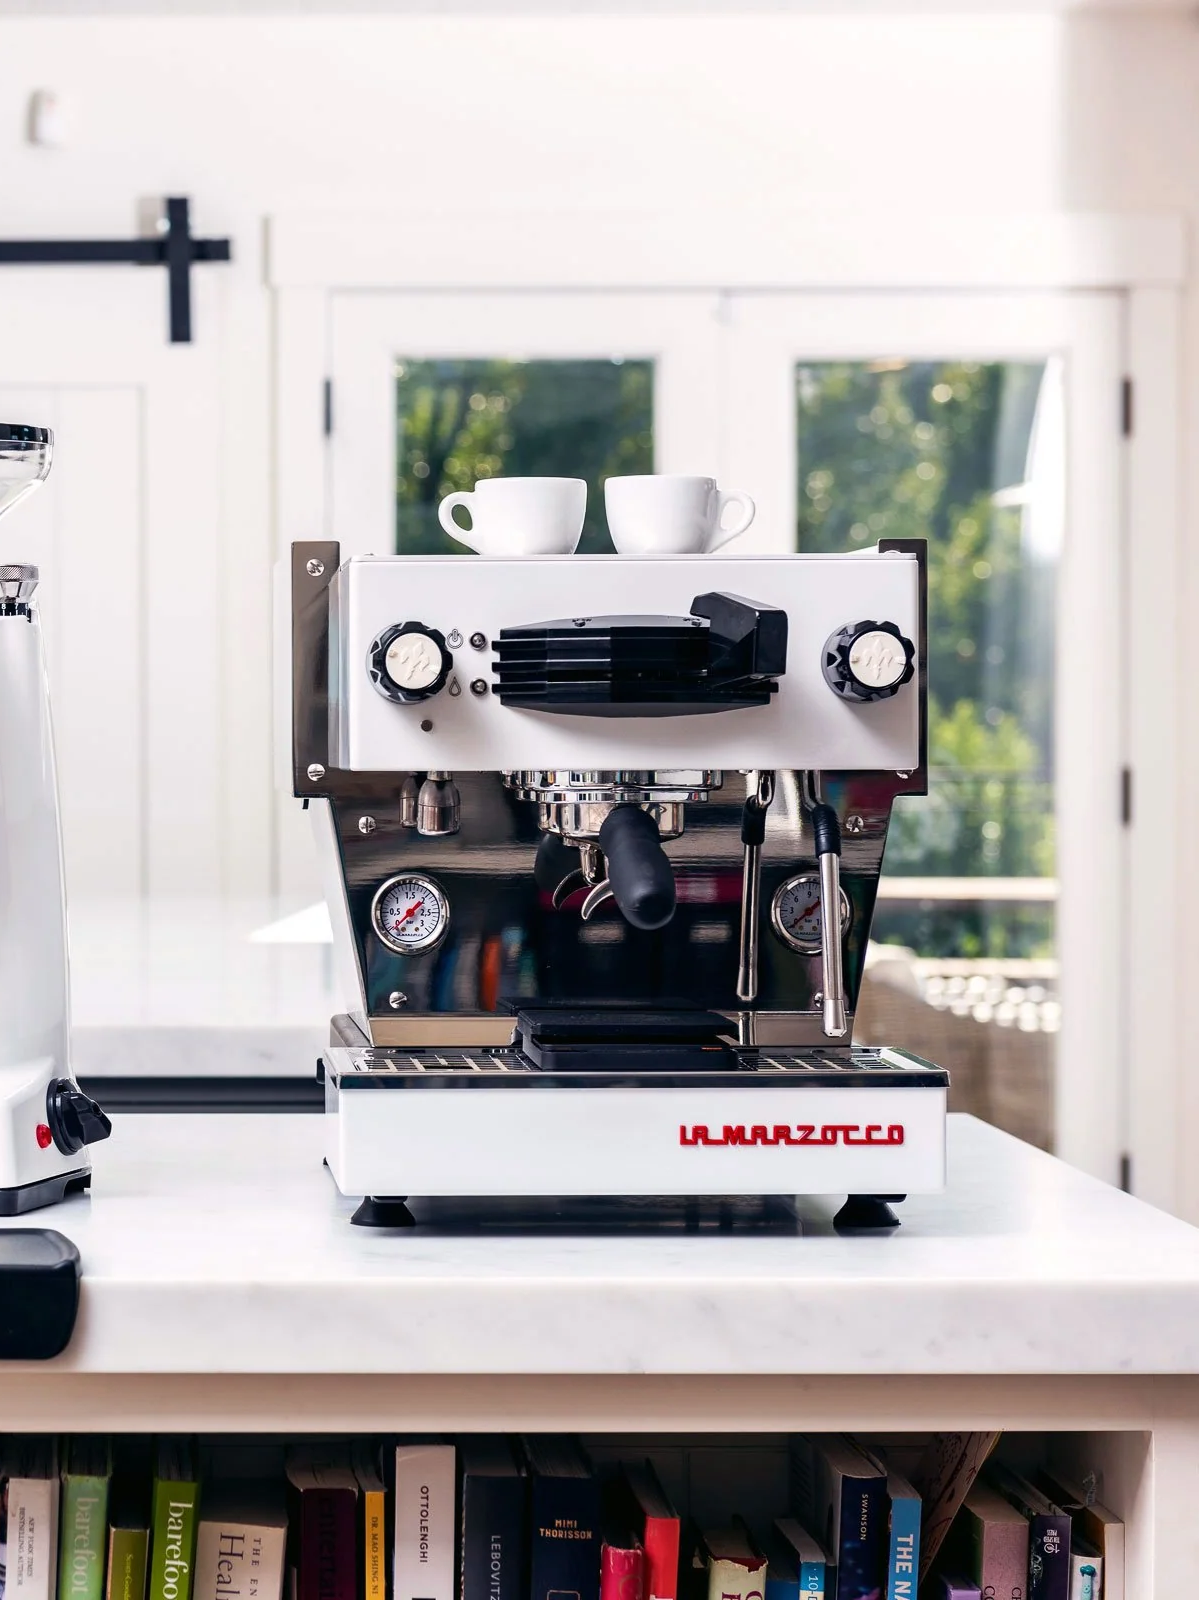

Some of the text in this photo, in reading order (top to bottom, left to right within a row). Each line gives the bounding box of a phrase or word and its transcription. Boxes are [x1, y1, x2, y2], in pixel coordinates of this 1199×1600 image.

[405, 892, 415, 900] 1,5
[389, 908, 400, 916] 0,5
[420, 909, 431, 917] 2,5
[371, 1516, 379, 1531] DR.
[420, 1485, 429, 1563] OTTOLENGHI
[555, 1519, 578, 1529] MIMI
[860, 1493, 869, 1541] SWANSON
[371, 1533, 379, 1553] MAO
[539, 1528, 593, 1539] THORISSON
[71, 1497, 99, 1594] barefoot
[251, 1538, 261, 1566] THE
[895, 1533, 914, 1574] THE
[216, 1532, 245, 1600] Heal
[371, 1555, 379, 1582] SHING
